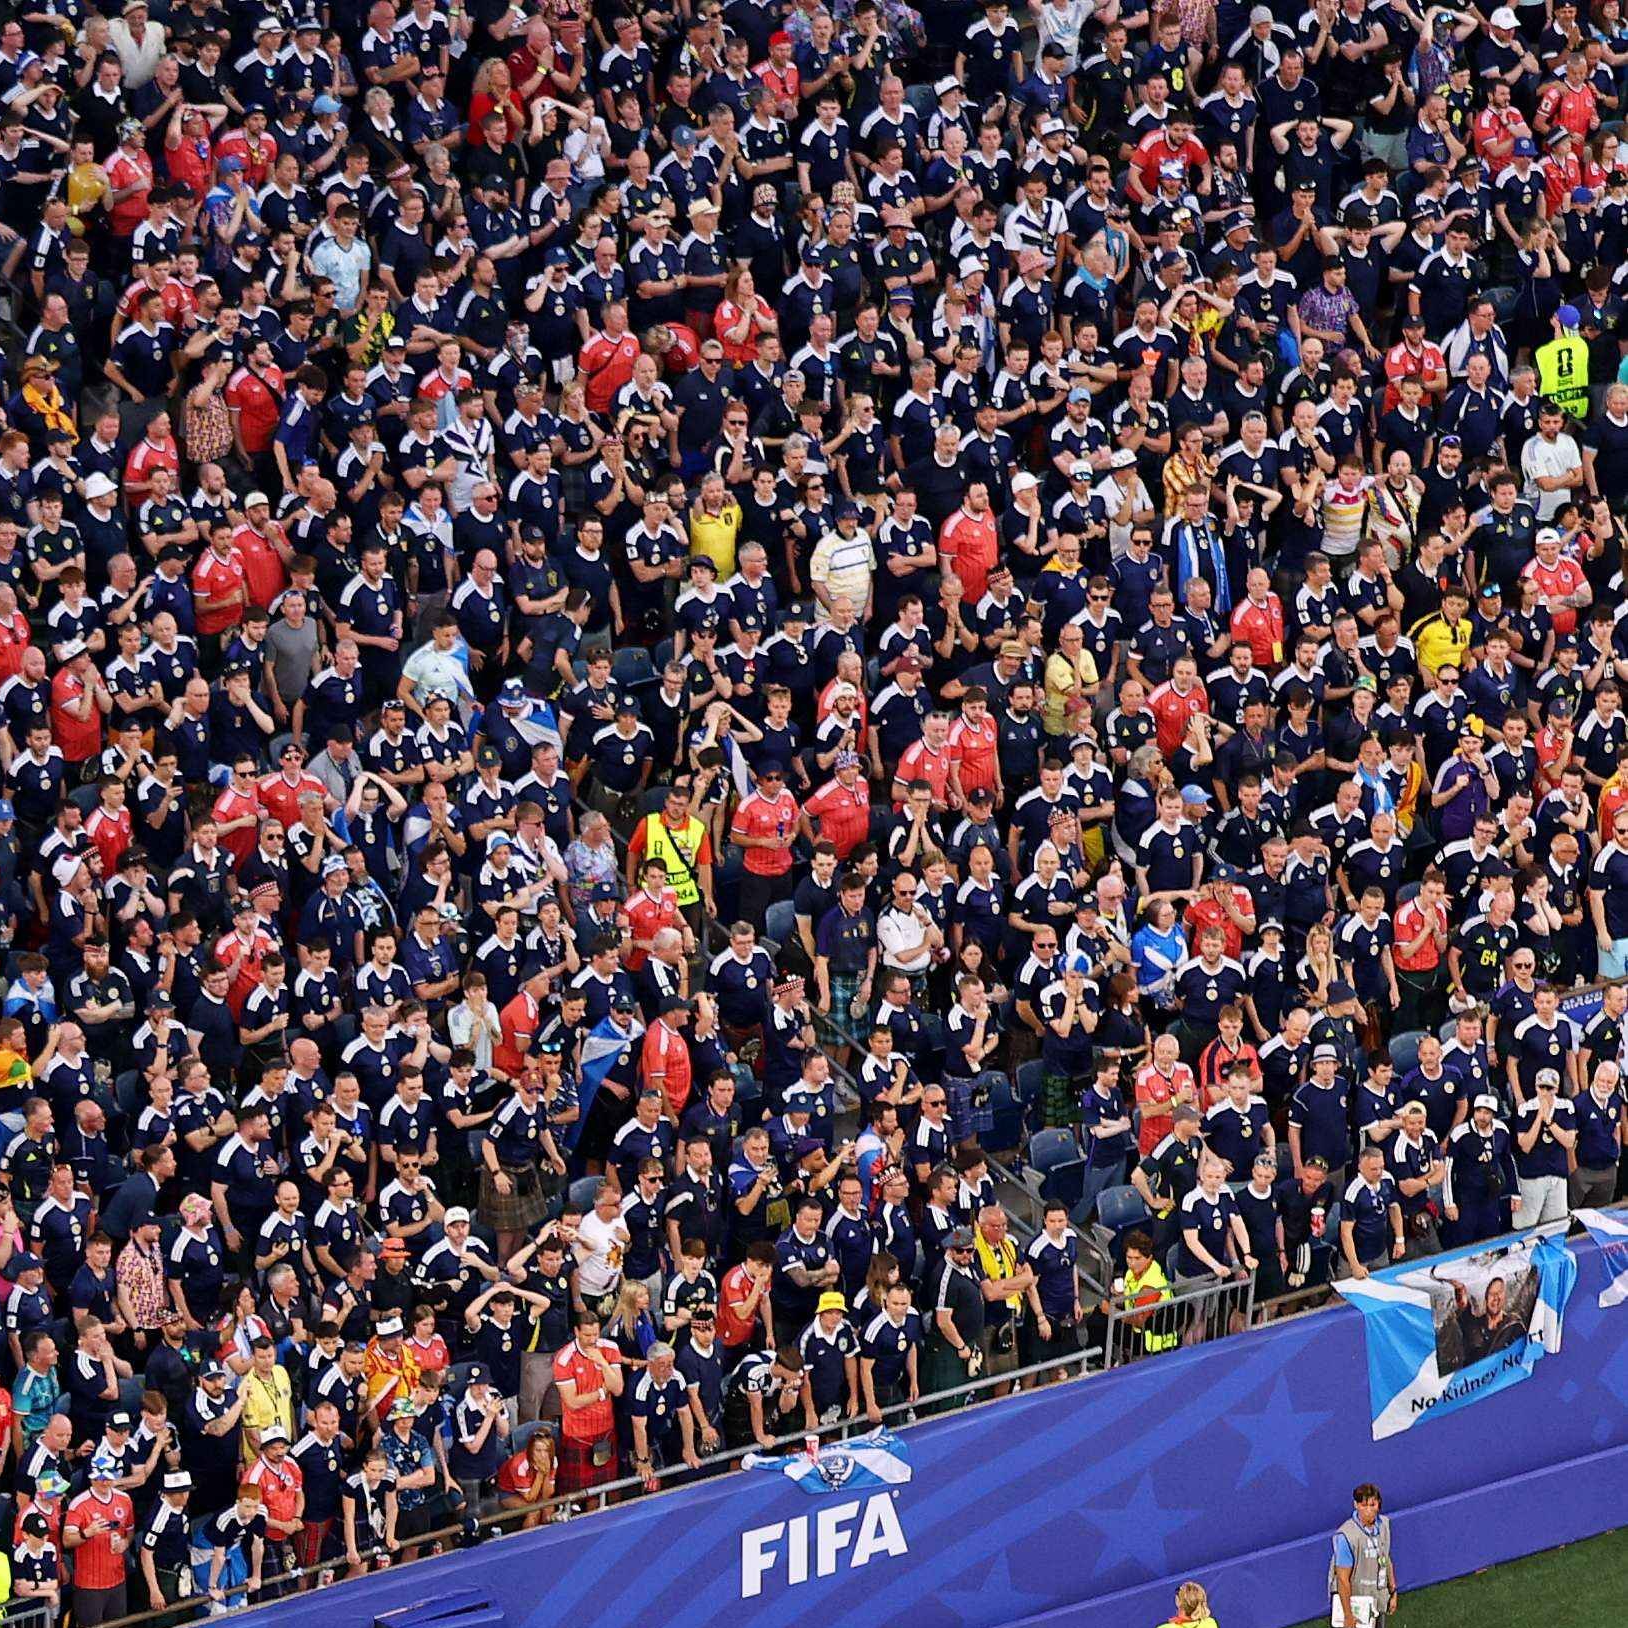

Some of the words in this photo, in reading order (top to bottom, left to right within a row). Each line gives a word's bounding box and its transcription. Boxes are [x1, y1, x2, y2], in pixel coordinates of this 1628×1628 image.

[1411, 1396, 1437, 1413] No
[1442, 1366, 1498, 1402] Kidney
[741, 1492, 909, 1598] FIFA
